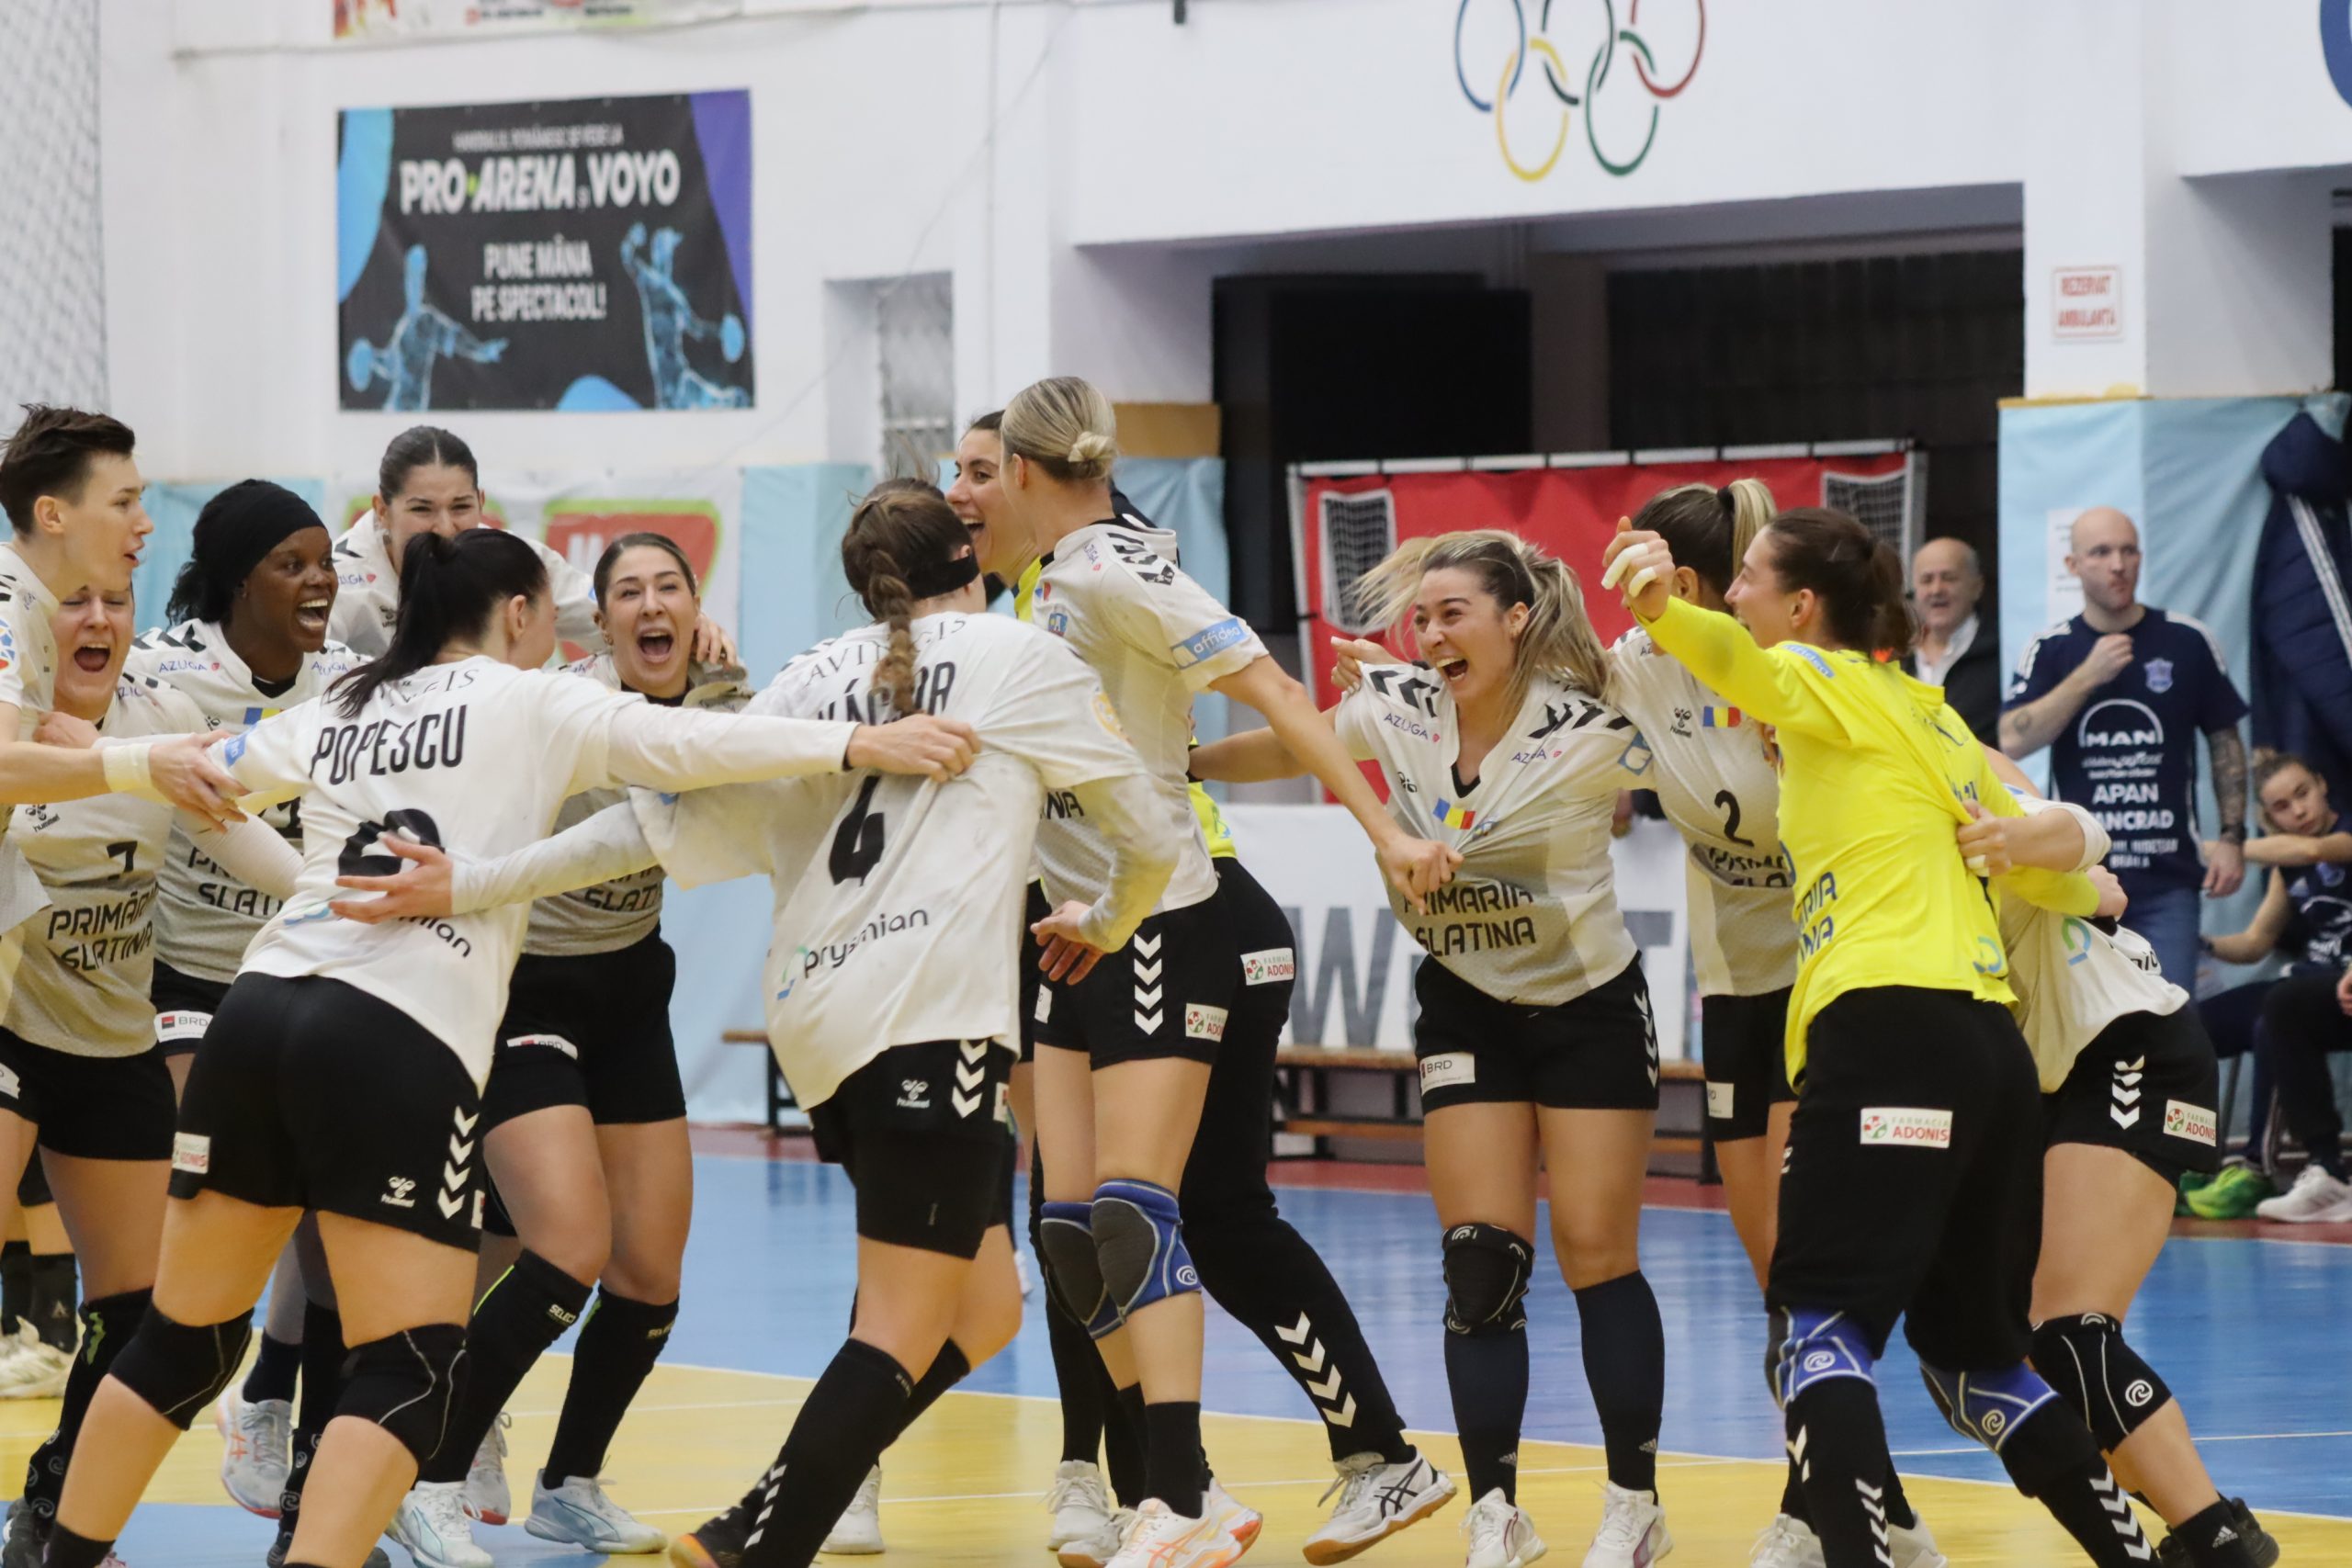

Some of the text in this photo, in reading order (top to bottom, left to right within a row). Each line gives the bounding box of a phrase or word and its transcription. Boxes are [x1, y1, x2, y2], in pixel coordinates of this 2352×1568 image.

[399, 156, 468, 215] PRO
[470, 152, 576, 213] ARENA
[586, 148, 682, 208] VOYO
[483, 231, 594, 280] PUNE MÂNA
[470, 281, 608, 322] PE SPECTACOL!
[1383, 712, 1430, 741] AZUGA
[2086, 729, 2156, 748] MAN
[309, 704, 468, 786] POPESCU
[2091, 783, 2160, 805] APAN
[2093, 808, 2176, 832] ANCRAD
[60, 920, 153, 971] SLATINA
[804, 908, 929, 979] prysmian
[1415, 916, 1537, 957] SLATINA
[177, 1016, 209, 1027] BRD
[1427, 1059, 1453, 1074] BRD
[1892, 1125, 1949, 1142] ADONIS
[2185, 1122, 2216, 1141] ADONIS
